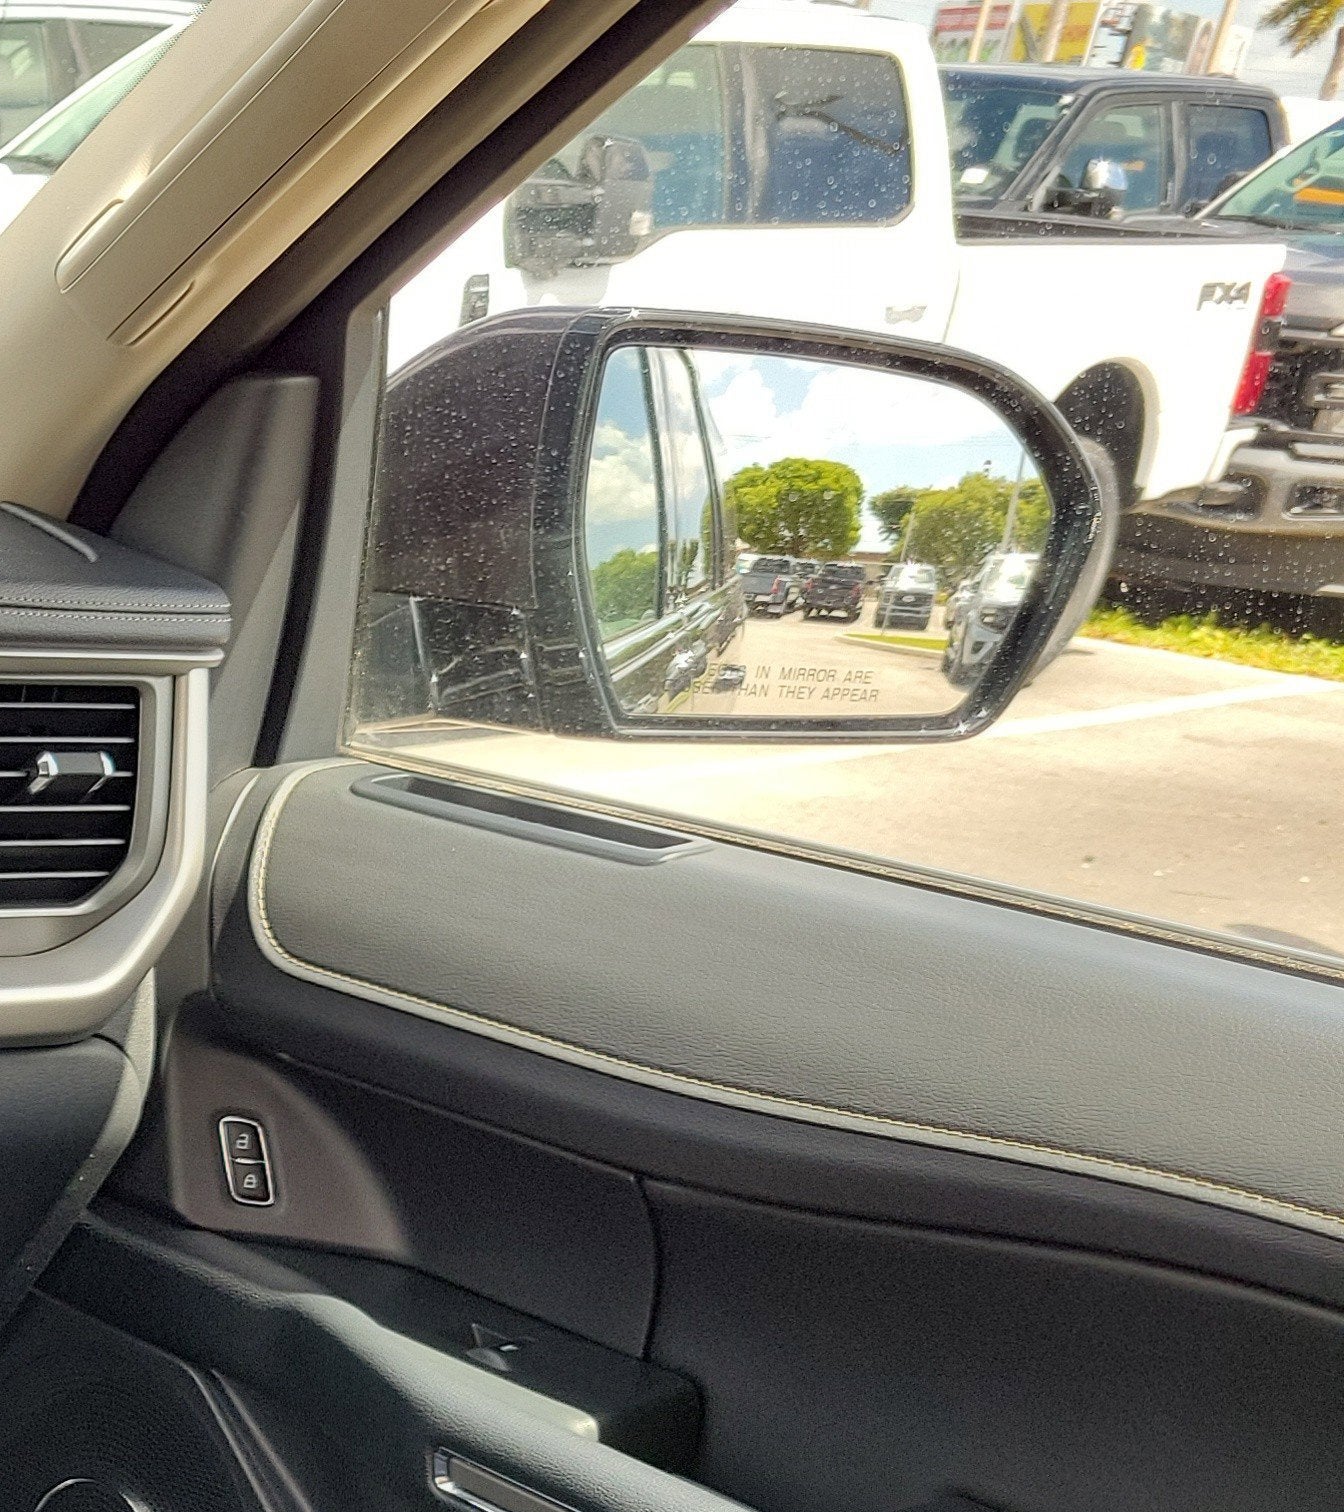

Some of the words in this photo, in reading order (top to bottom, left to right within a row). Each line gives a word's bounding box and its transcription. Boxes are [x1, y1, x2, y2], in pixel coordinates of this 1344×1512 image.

[755, 665, 771, 679] IN
[779, 666, 837, 683] MIRROR
[843, 669, 875, 685] ARE
[778, 684, 816, 700] THEY
[820, 686, 880, 702] APPEAR
